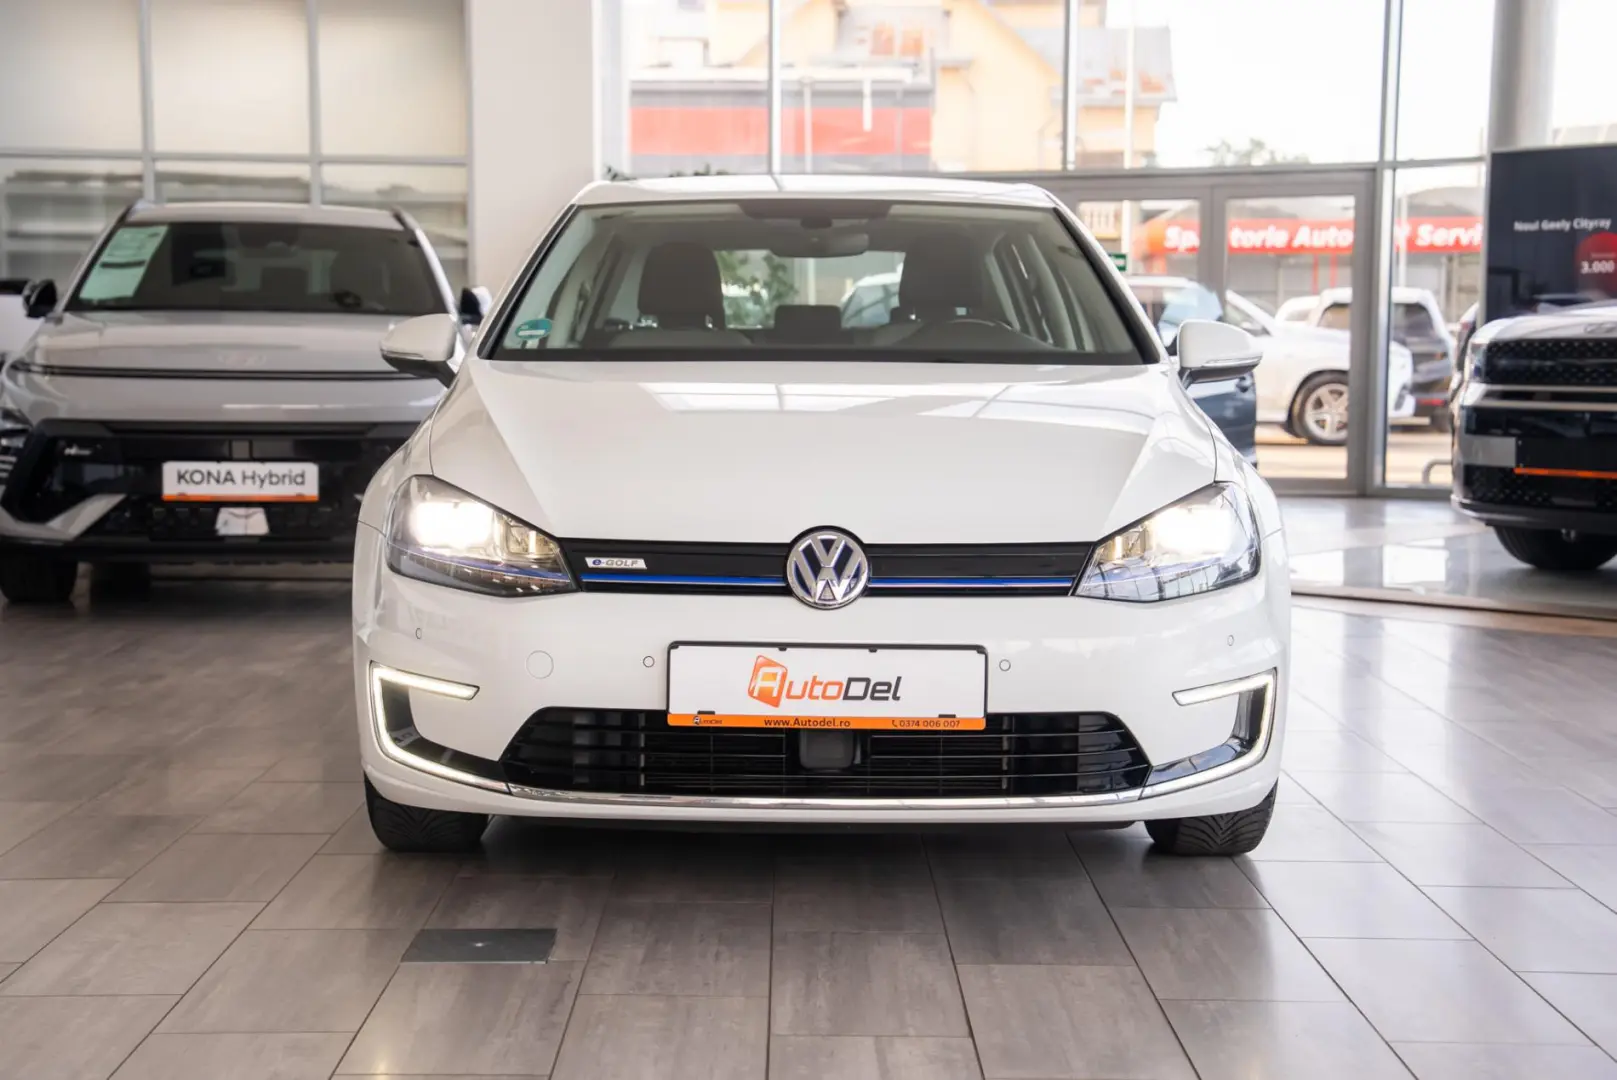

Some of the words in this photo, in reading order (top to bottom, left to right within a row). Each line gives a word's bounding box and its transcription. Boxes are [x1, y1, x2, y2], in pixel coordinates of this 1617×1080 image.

[1292, 225, 1353, 248] Auto
[1415, 222, 1482, 247] Servi
[176, 469, 236, 485] KONA
[242, 469, 306, 488] Hybrid
[752, 664, 902, 702] AutoDel
[764, 717, 851, 728] www.Autodel.ro
[900, 719, 920, 728] 0374
[923, 719, 940, 728] 006
[943, 719, 960, 728] 007
